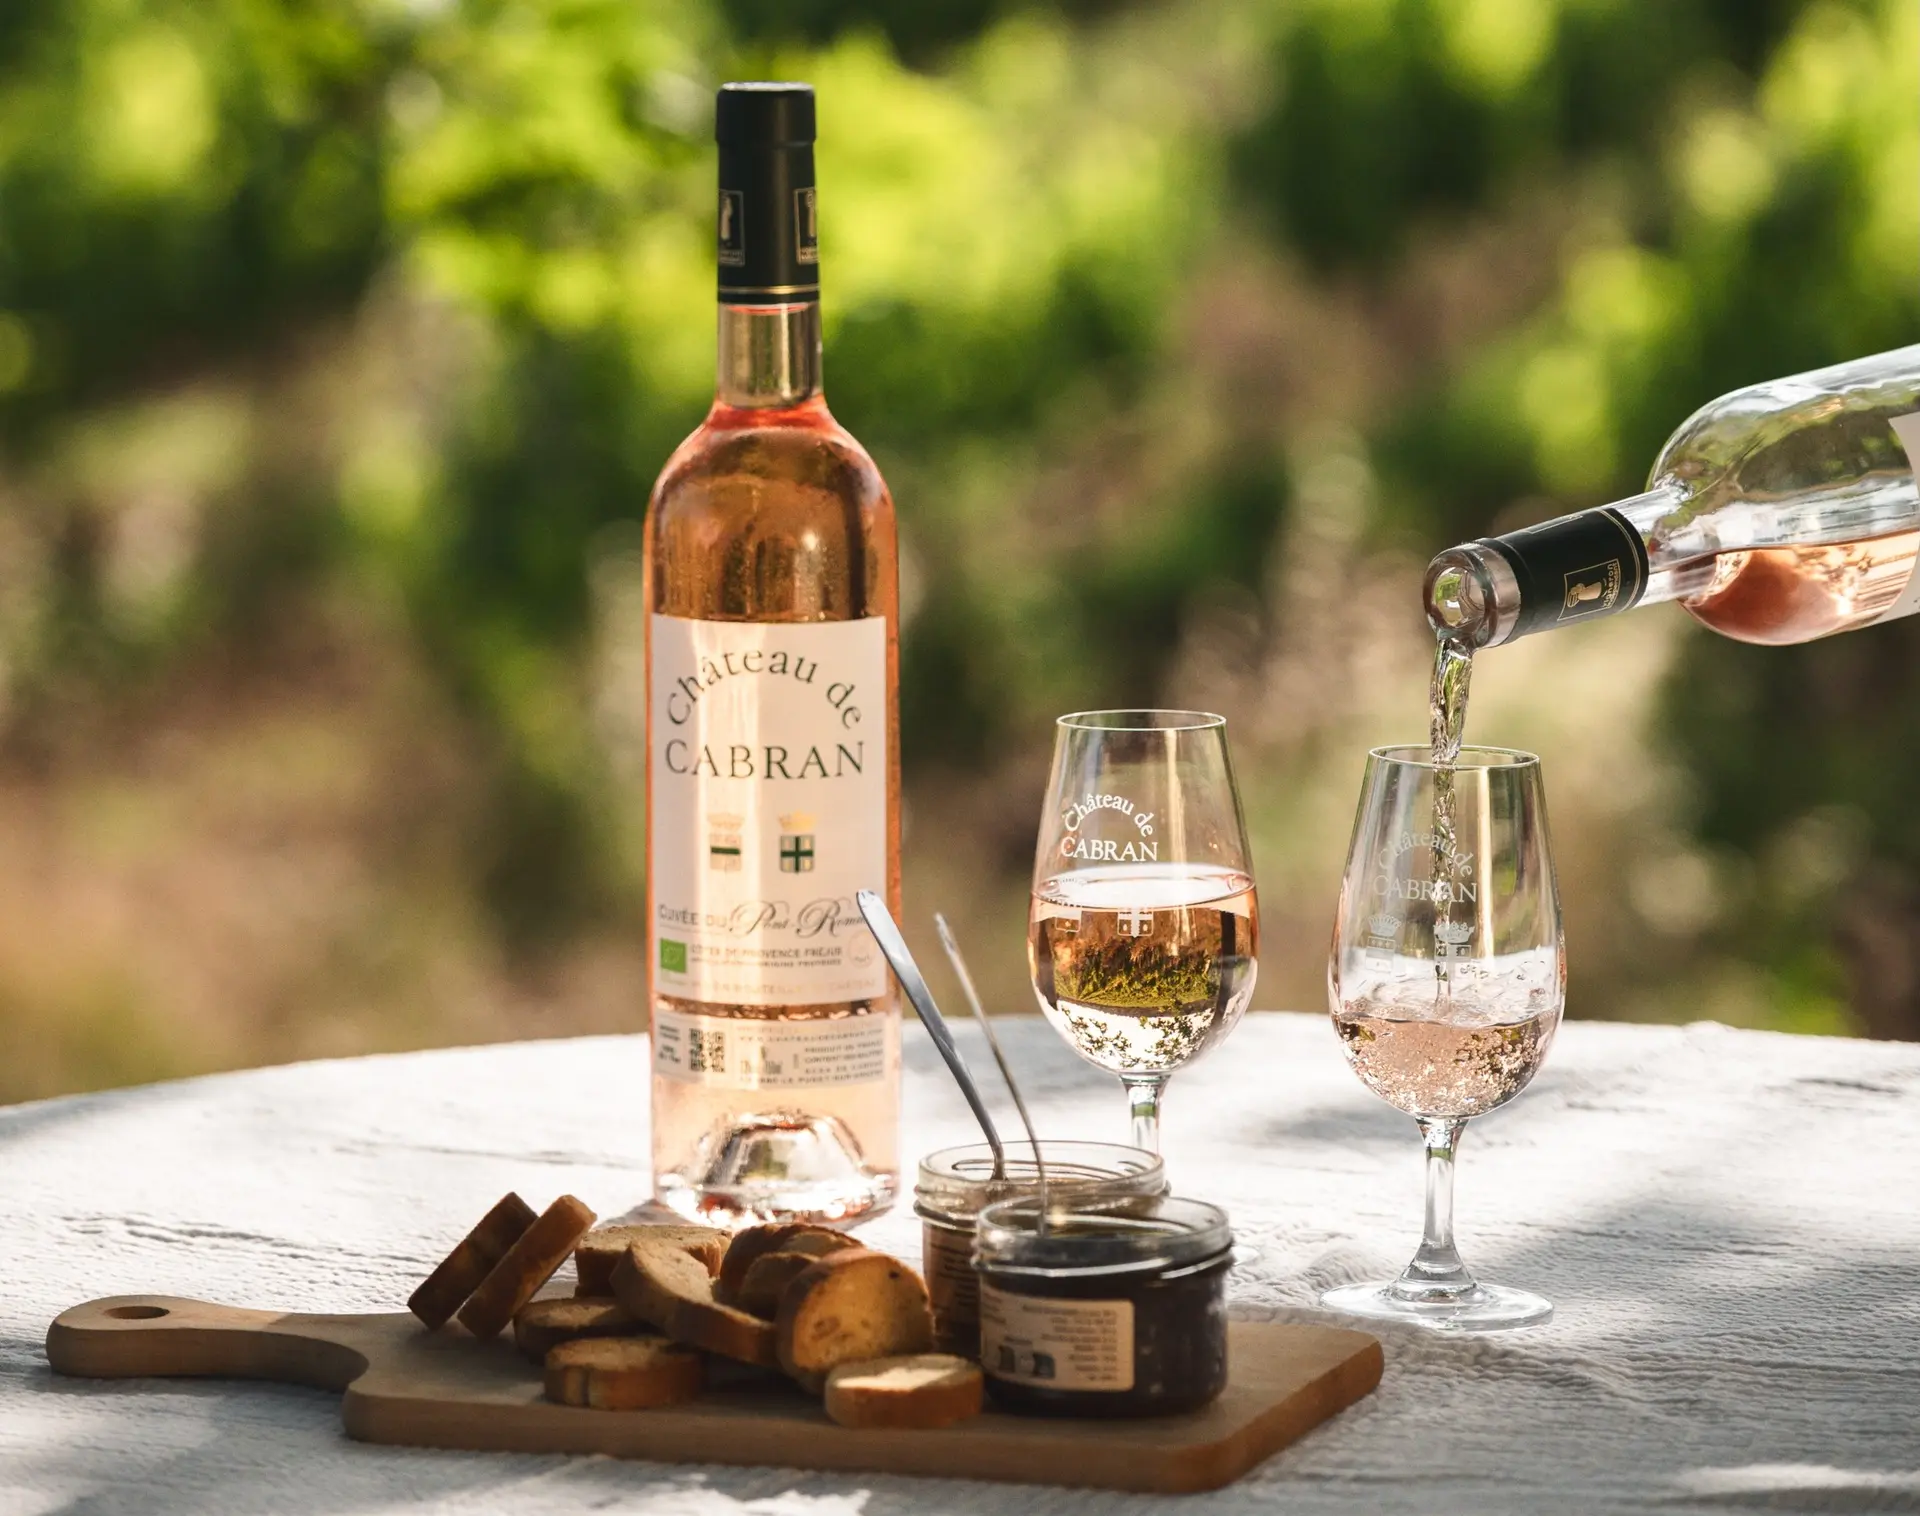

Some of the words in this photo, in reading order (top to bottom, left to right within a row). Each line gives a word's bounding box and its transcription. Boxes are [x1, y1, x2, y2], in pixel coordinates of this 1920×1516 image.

[667, 649, 819, 726] Château
[826, 680, 863, 730] de
[665, 738, 865, 780] CABRAN
[1063, 792, 1135, 832] Château
[1134, 811, 1155, 838] de
[1060, 836, 1159, 862] CABRAN
[1379, 831, 1453, 870] Château
[1453, 851, 1474, 878] de
[1373, 874, 1478, 903] CABRAN
